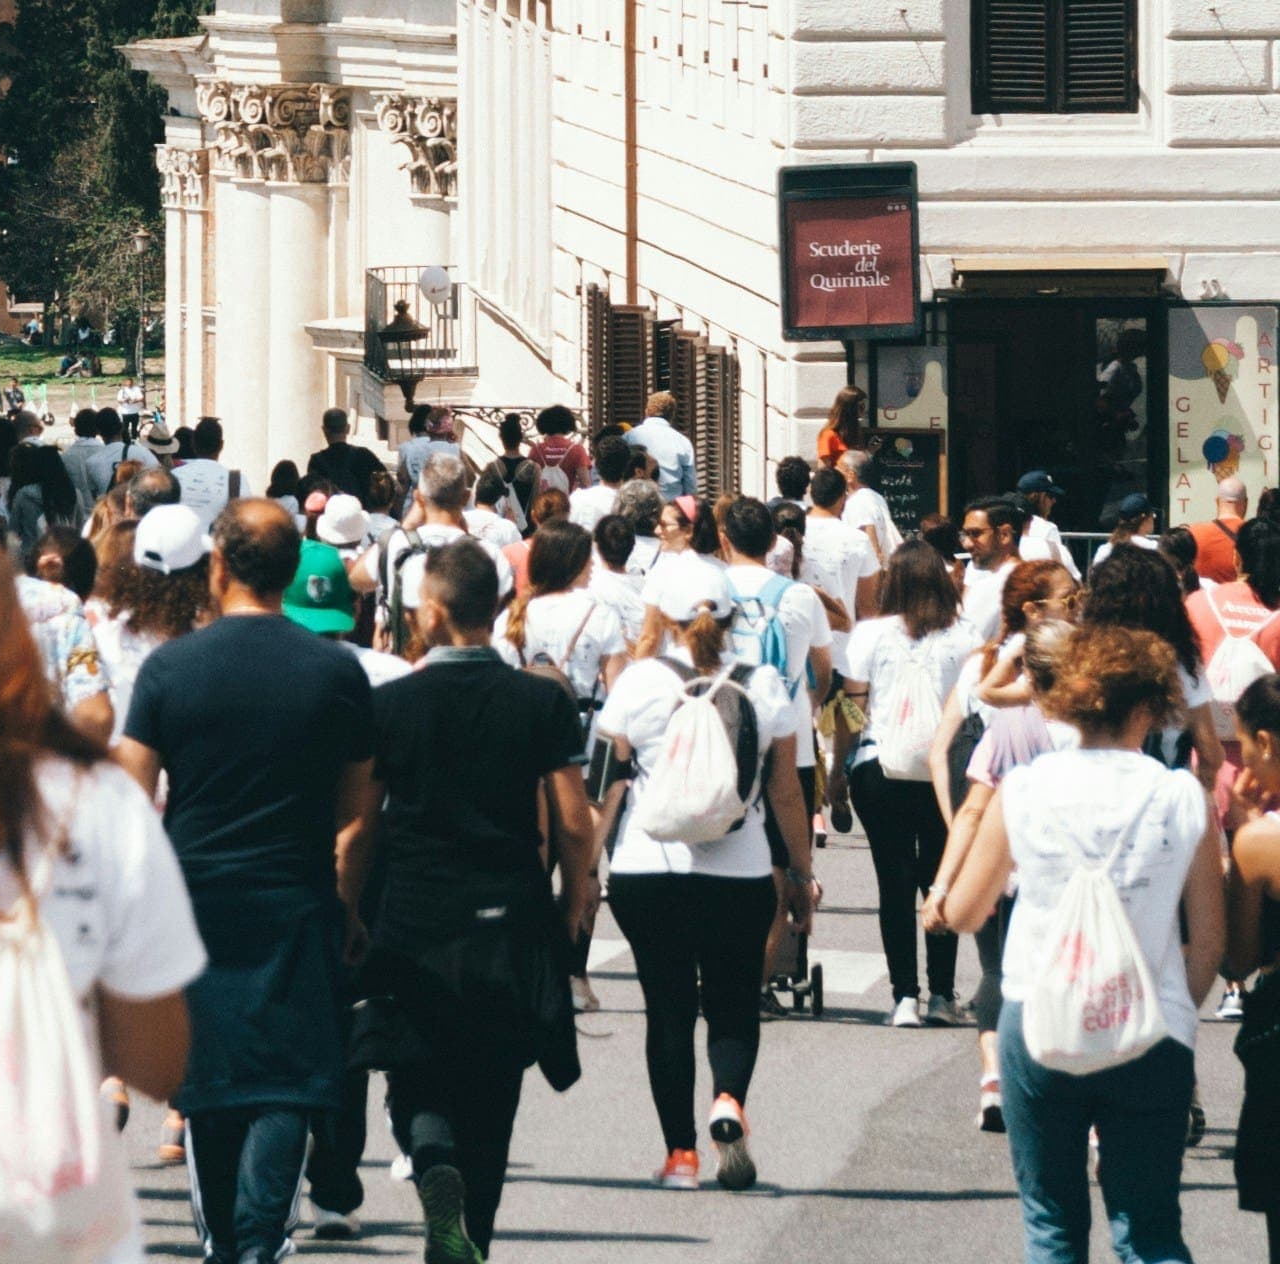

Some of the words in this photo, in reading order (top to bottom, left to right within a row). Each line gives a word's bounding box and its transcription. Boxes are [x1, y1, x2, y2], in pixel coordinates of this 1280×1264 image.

[809, 240, 881, 257] Scuderie
[855, 256, 878, 273] del
[810, 272, 890, 292] Quirinale
